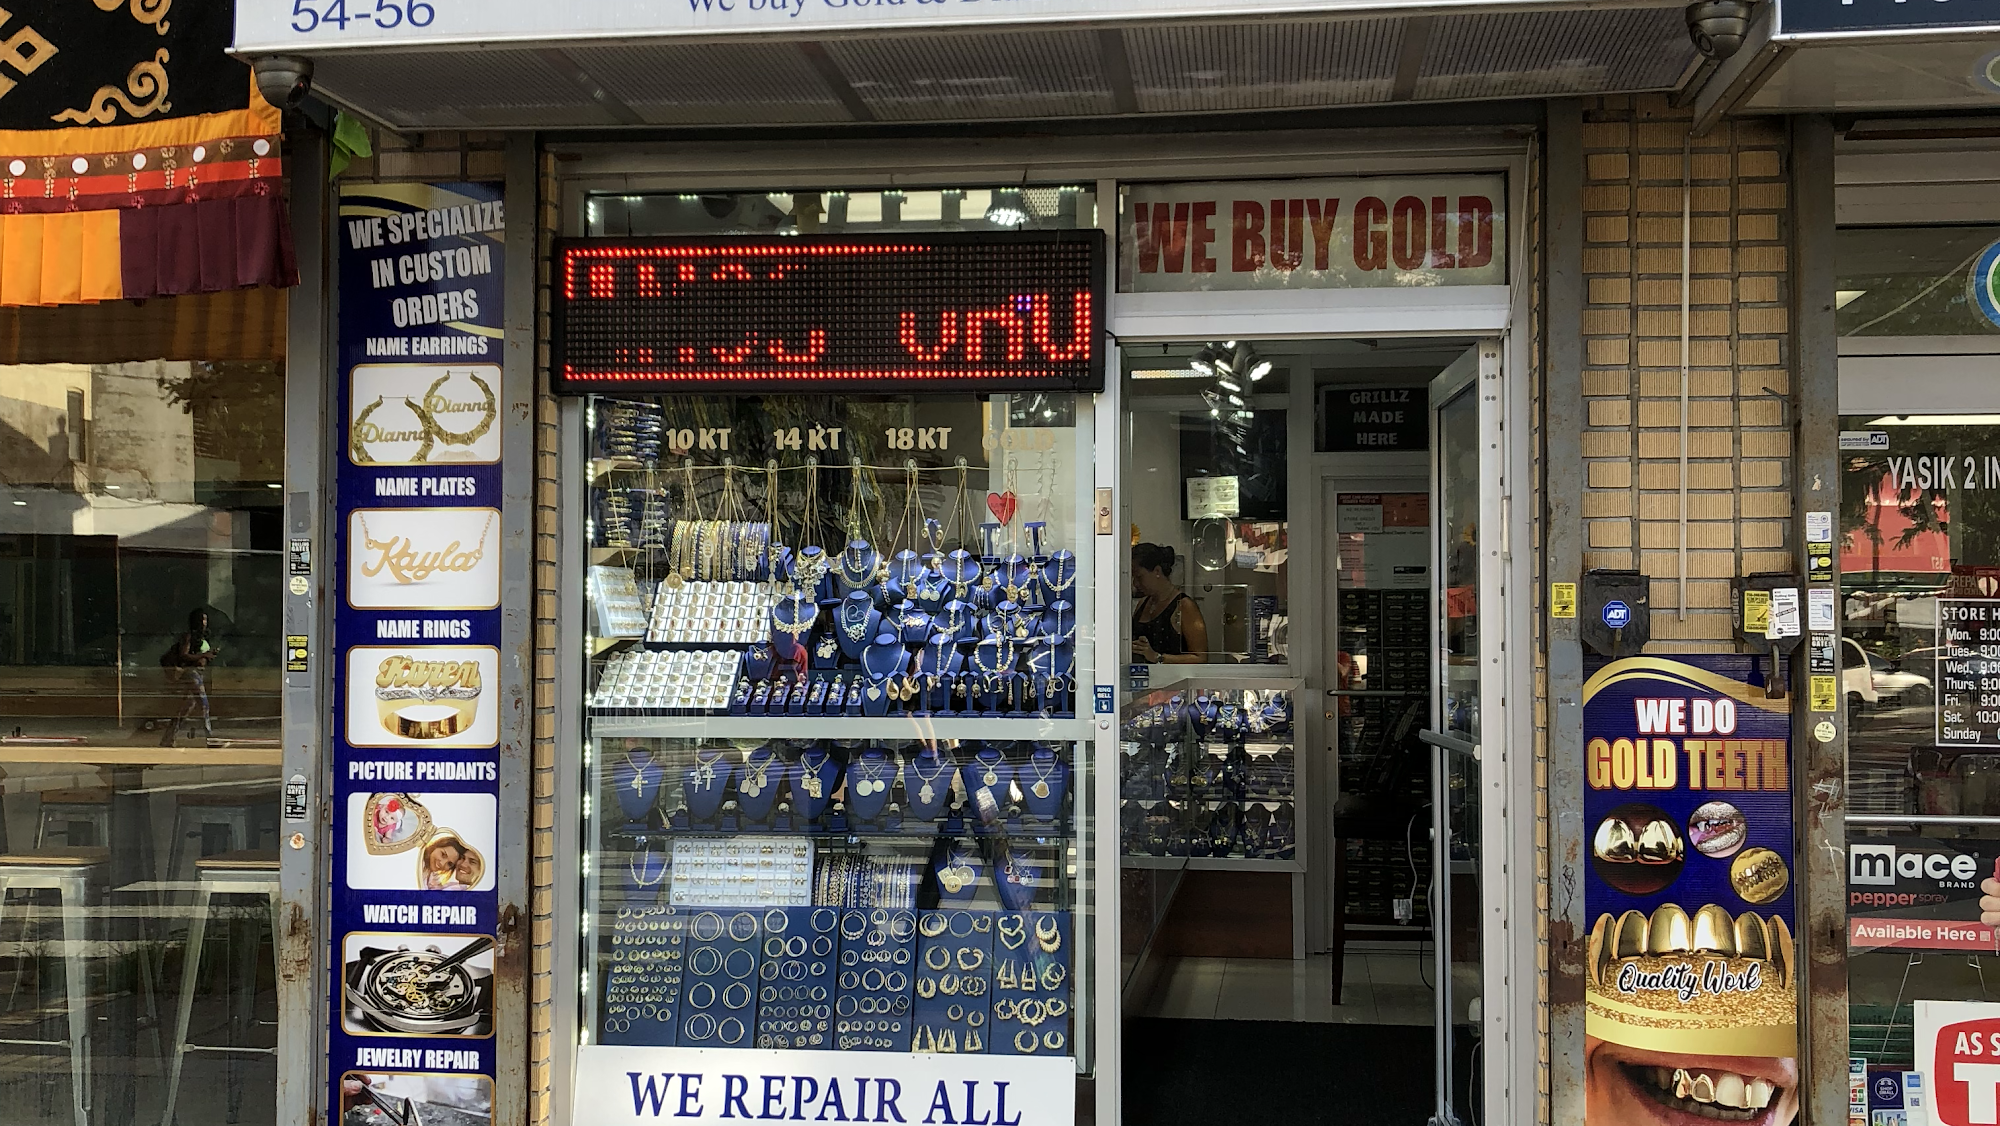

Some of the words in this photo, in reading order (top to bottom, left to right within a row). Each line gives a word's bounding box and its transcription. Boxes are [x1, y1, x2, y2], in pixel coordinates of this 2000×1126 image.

[291, 0, 435, 33] 54-56
[348, 217, 385, 250] WE
[387, 200, 505, 245] SPECIALIZE
[1134, 202, 1217, 274] WE
[1231, 197, 1340, 273] BUY
[1353, 195, 1493, 272] GOLD
[371, 257, 396, 289] IN
[399, 244, 492, 285] CUSTOM
[392, 288, 479, 328] ORDERS
[366, 337, 409, 356] NAME
[412, 336, 488, 355] EARRINGS
[1349, 390, 1410, 404] GRILLZ
[1353, 410, 1404, 424] MADE
[665, 428, 695, 450] 10
[699, 427, 732, 450] KT
[773, 427, 803, 450] 14
[808, 427, 842, 450] KT
[885, 427, 915, 450] 18
[918, 427, 952, 450] KT
[982, 429, 1056, 450] GOLD
[1356, 432, 1398, 446] HERE
[1871, 435, 1887, 444] ADT
[1886, 455, 1957, 490] YASIK
[1963, 455, 1976, 490] 2
[375, 477, 418, 496] NAME
[421, 476, 476, 496] PLATES
[361, 535, 480, 585] Kayla
[1607, 609, 1627, 619] ADT
[1942, 607, 1986, 620] STORE
[376, 619, 420, 639] NAME
[423, 619, 471, 639] RINGS
[1946, 627, 1972, 640] Mon.
[376, 655, 482, 688] Karen
[1945, 661, 1974, 674] Wed.
[1944, 677, 1977, 690] Thurs.
[1981, 678, 2000, 691] 9:0
[1944, 694, 1961, 706] Fri.
[1980, 694, 2000, 707] 9:0
[1635, 698, 1688, 735] WE
[1691, 698, 1737, 735] DO
[1943, 710, 1965, 723] Sat.
[1976, 710, 2000, 724] 10:0
[1943, 726, 1981, 743] Sunday
[348, 761, 413, 781] PICTURE
[416, 761, 497, 781] PENDANTS
[1587, 737, 1677, 790] GOLD
[1683, 738, 1789, 792] TEETH
[1938, 881, 1976, 889] BRAND
[1850, 891, 1917, 907] pepper
[1918, 893, 1949, 904] spray
[363, 904, 418, 925] WATCH
[421, 905, 477, 926] REPAIR
[1855, 924, 1932, 940] Available
[1937, 926, 1977, 941] Here
[1618, 962, 1700, 1003] Quality
[1702, 960, 1762, 996] Work
[1953, 1031, 1984, 1056] AS
[355, 1047, 423, 1068] JEWELRY
[425, 1049, 480, 1070] REPAIR
[626, 1071, 704, 1117] WE
[719, 1073, 908, 1124] REPAIR
[922, 1079, 1023, 1126] ALL
